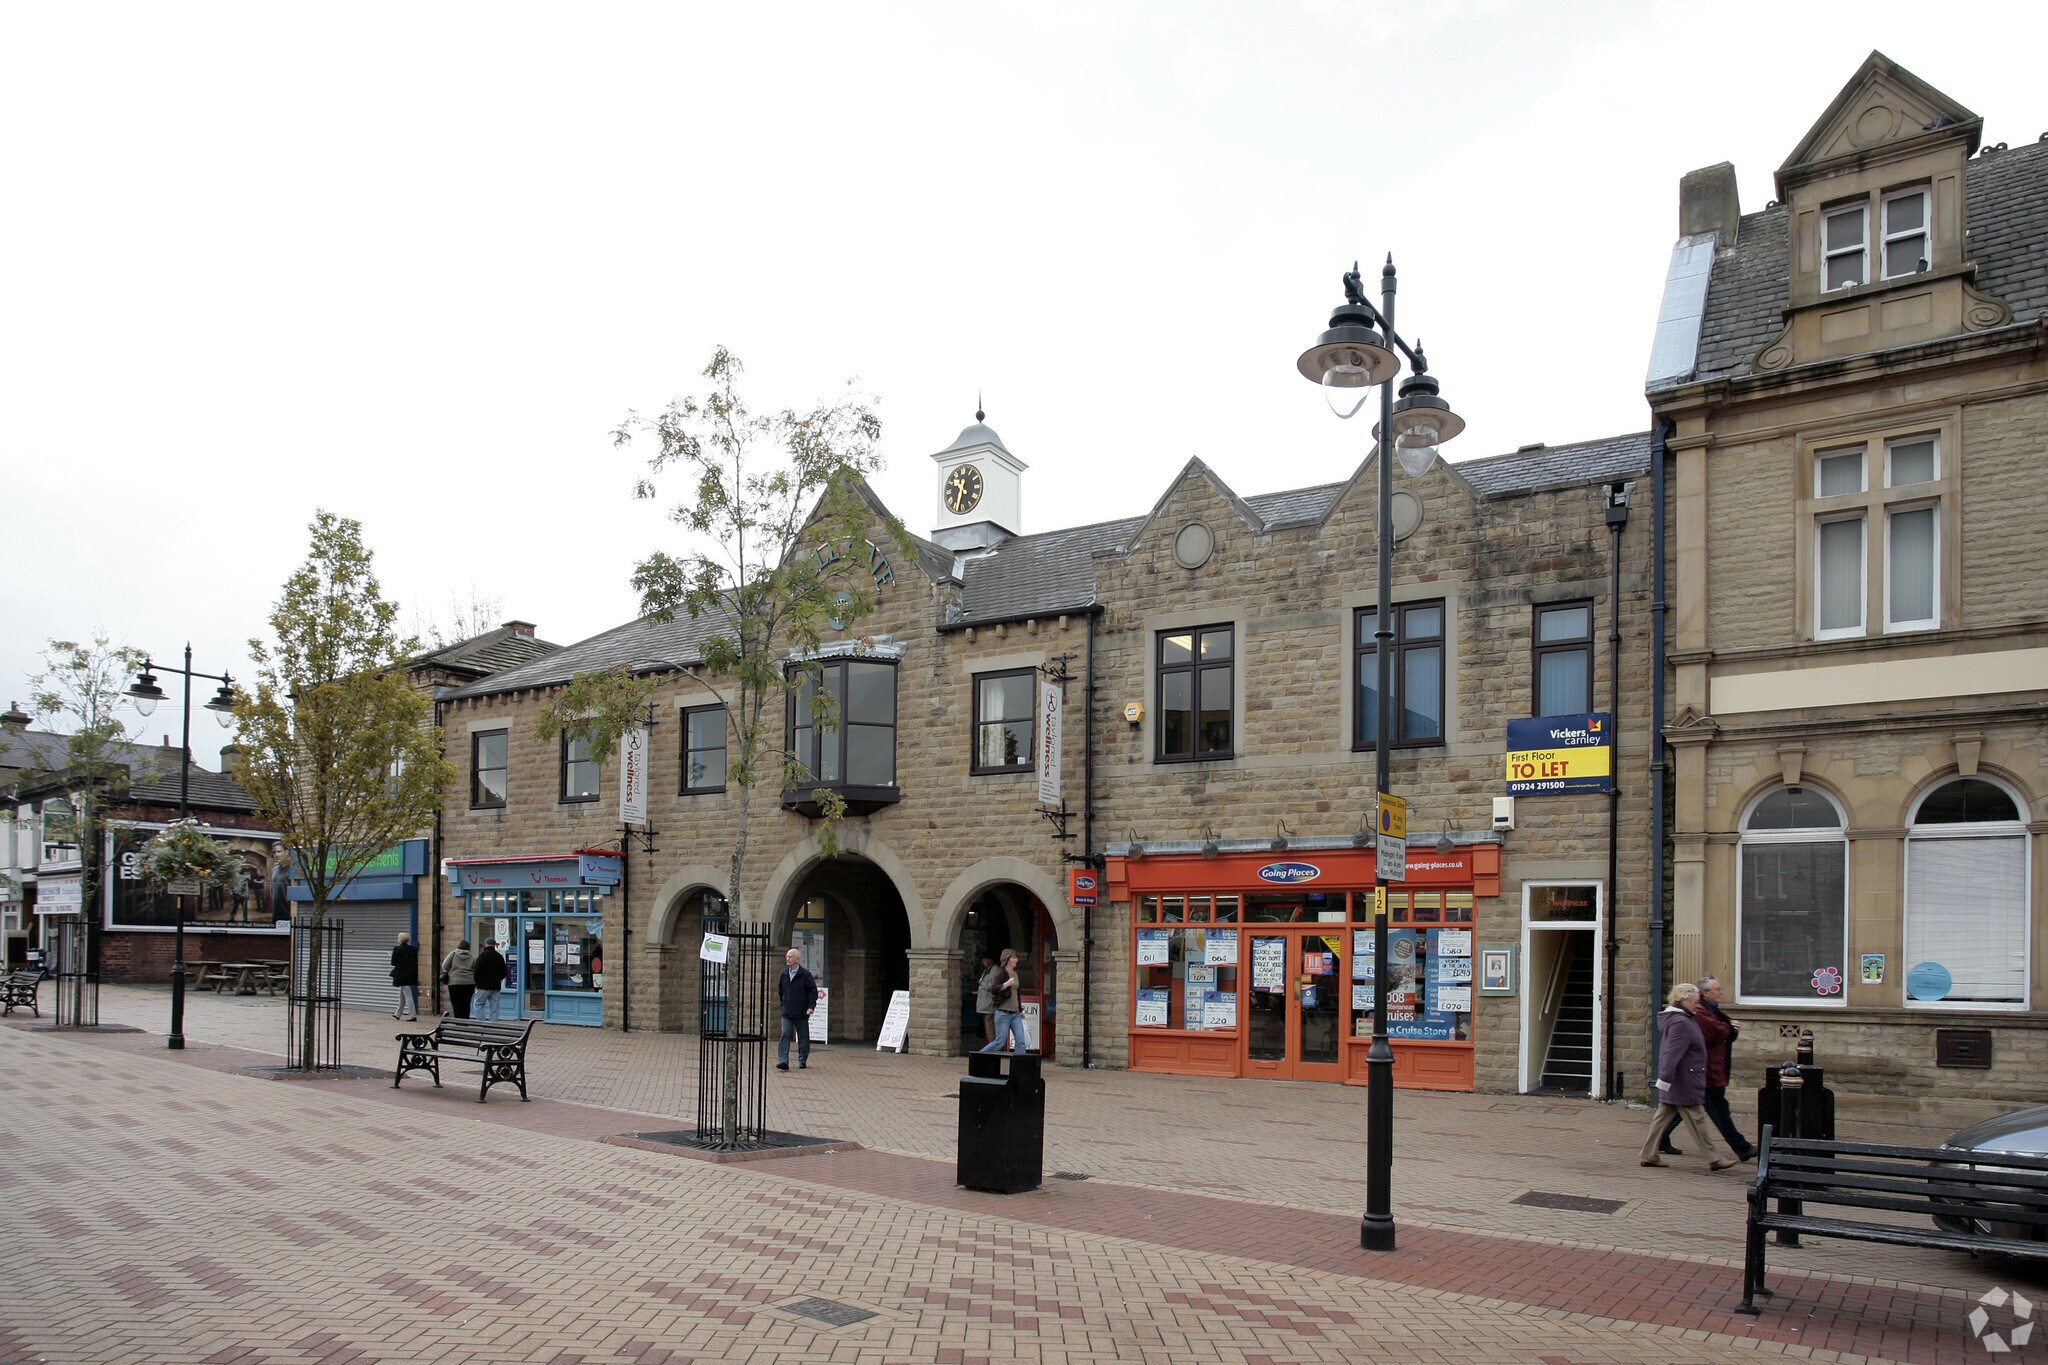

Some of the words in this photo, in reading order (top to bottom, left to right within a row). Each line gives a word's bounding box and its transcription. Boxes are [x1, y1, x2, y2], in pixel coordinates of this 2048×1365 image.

[1550, 728, 1586, 739] Vickers
[1044, 713, 1052, 778] wellness
[1564, 734, 1601, 746] carnley
[1511, 753, 1529, 762] First
[1532, 752, 1555, 761] Floor
[634, 753, 642, 795] taylored
[1512, 763, 1535, 779] TO
[1541, 761, 1569, 777] LET
[626, 751, 635, 803] wellness
[1511, 782, 1535, 791] 01924
[1536, 781, 1565, 790] 291500
[1262, 869, 1286, 879] Going
[1288, 868, 1315, 876] Places
[1377, 890, 1382, 899] 1
[1376, 900, 1382, 909] 2
[1400, 940, 1410, 949] FREE
[1387, 1010, 1414, 1021] ruises
[1396, 1026, 1422, 1035] Cruise
[1424, 1026, 1448, 1036] Store
